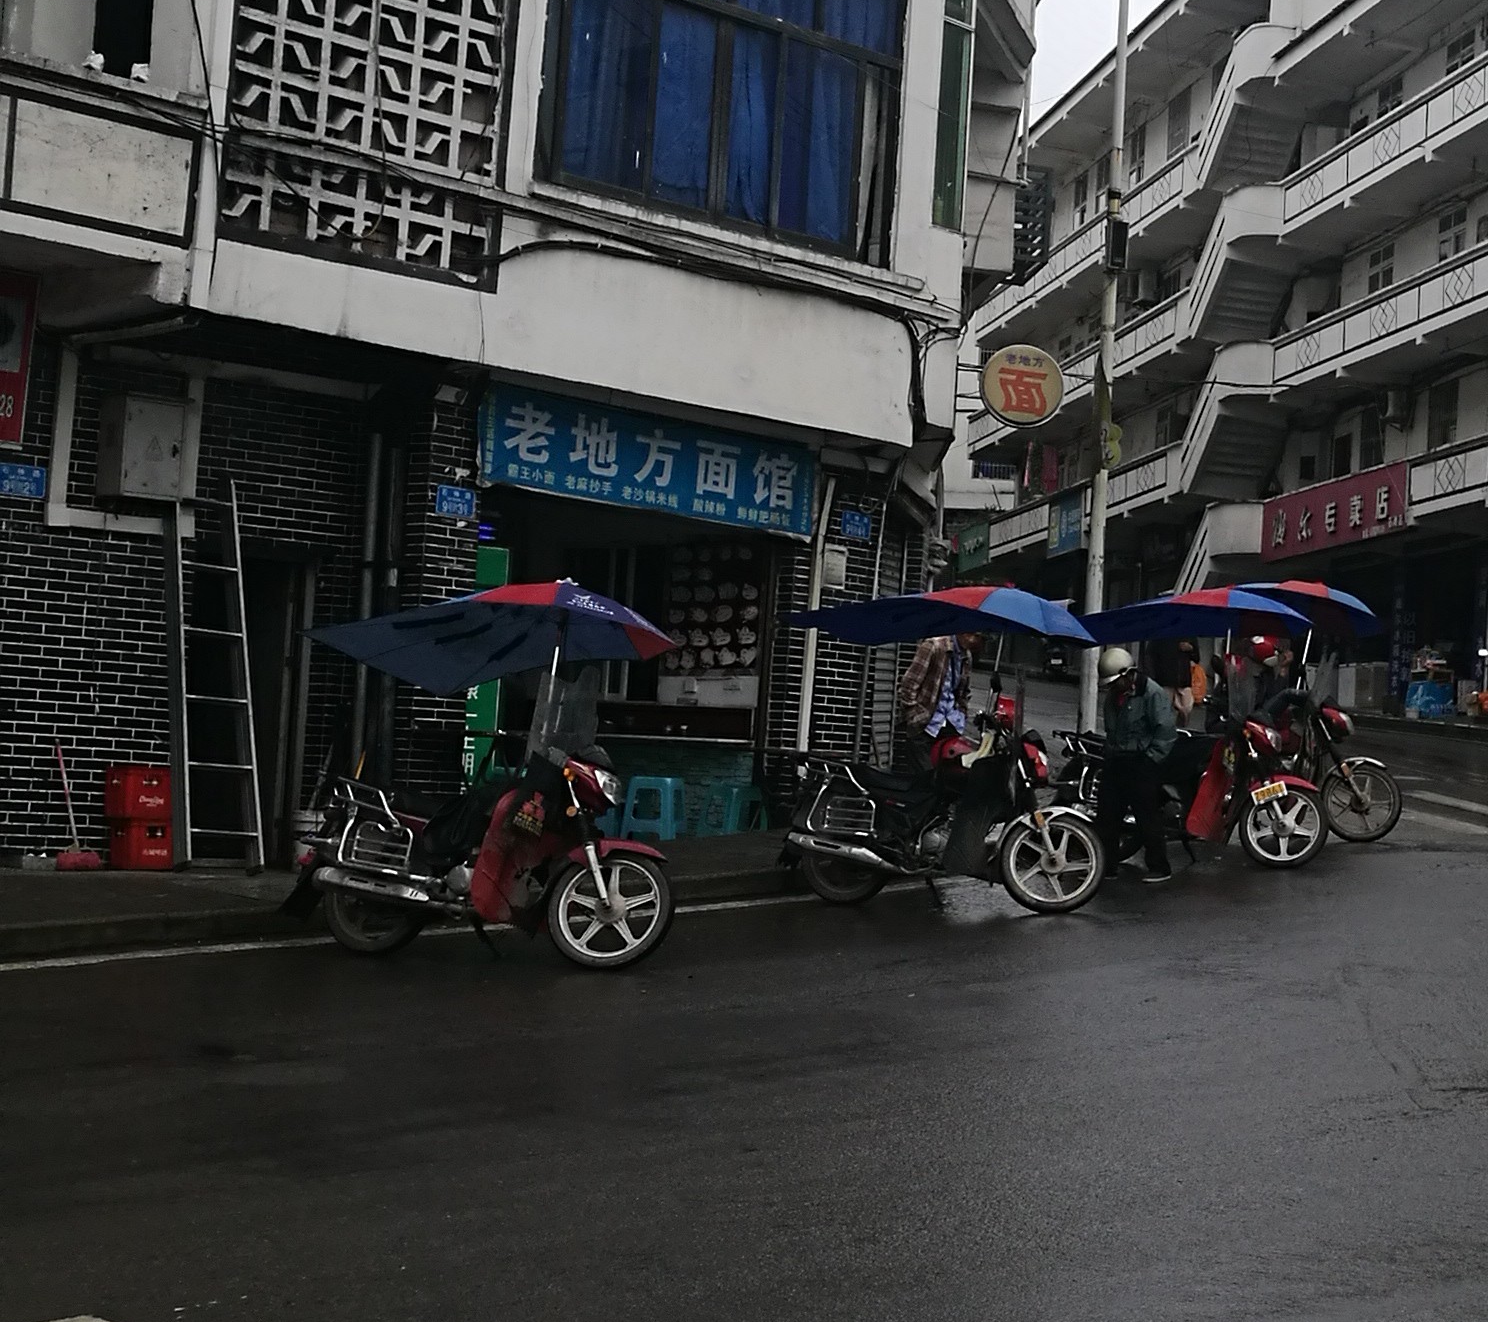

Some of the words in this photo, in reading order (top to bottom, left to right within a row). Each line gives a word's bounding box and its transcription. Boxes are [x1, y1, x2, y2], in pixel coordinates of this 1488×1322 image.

[1005, 353, 1045, 368] 老地方
[998, 367, 1049, 418] 面
[502, 401, 799, 512] 老地方面馆
